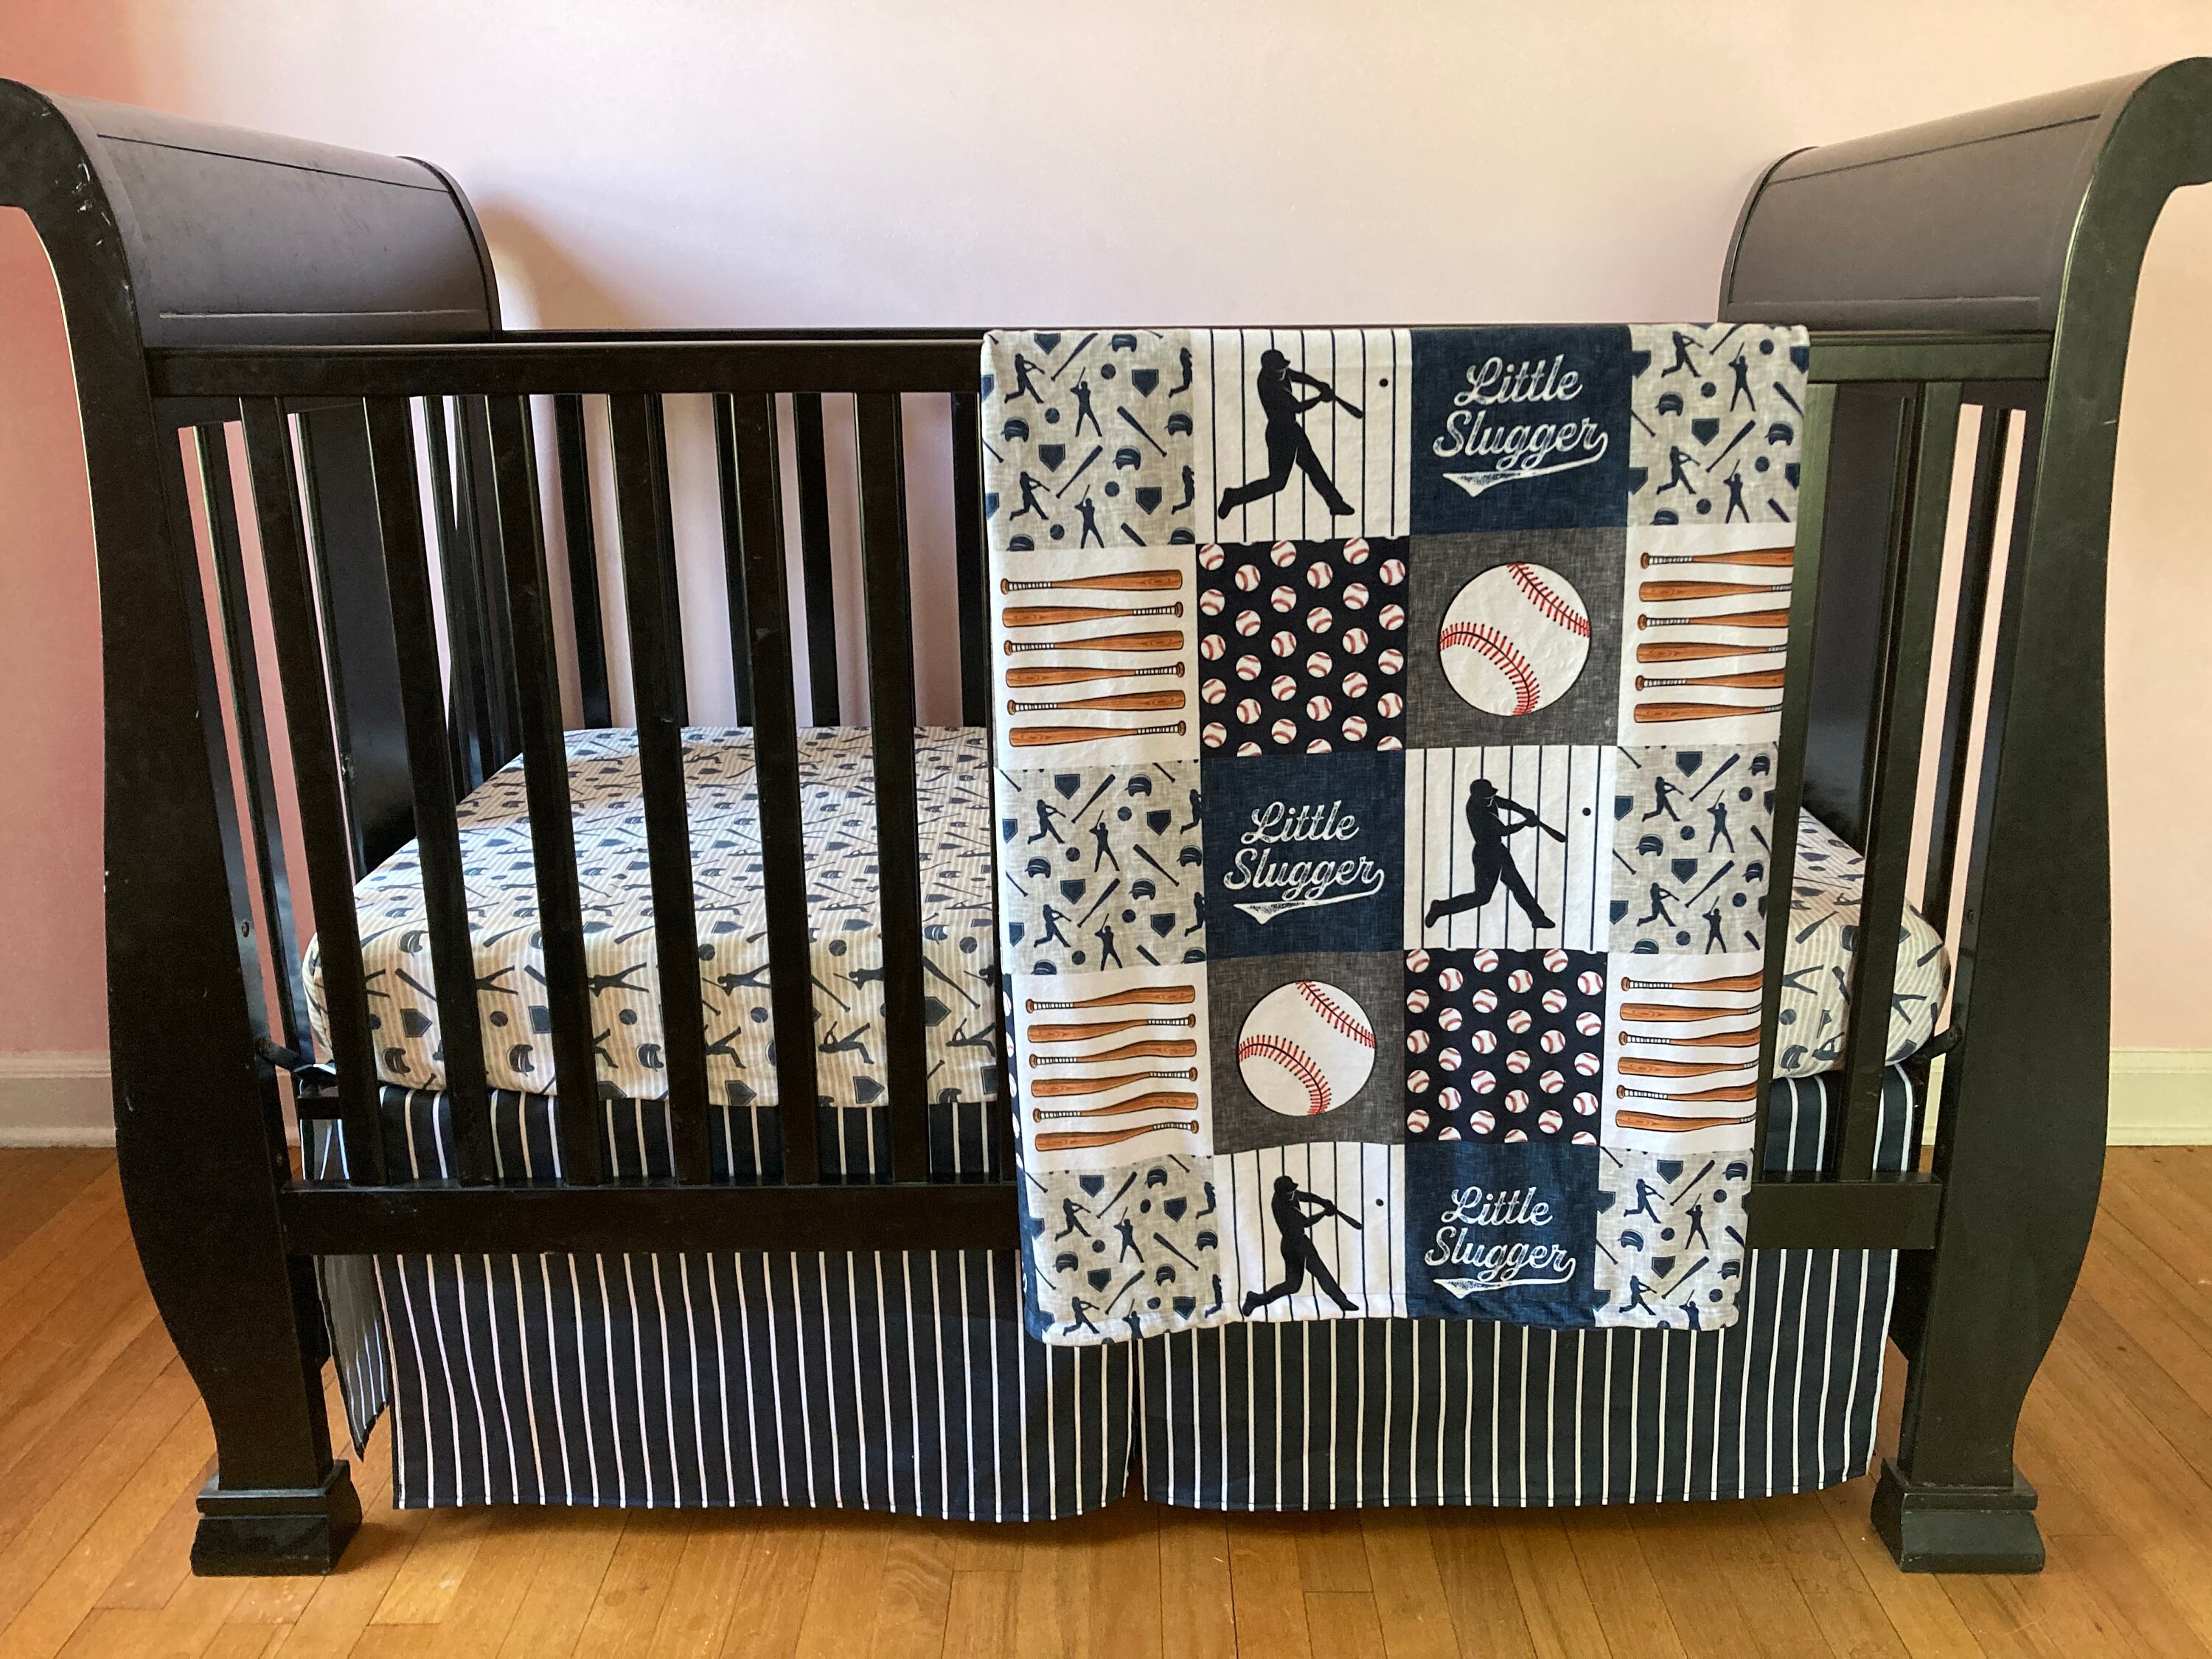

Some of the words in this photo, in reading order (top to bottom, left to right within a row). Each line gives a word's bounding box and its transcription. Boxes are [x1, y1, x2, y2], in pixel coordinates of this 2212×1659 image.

[1453, 353, 1583, 406] Little
[1433, 409, 1609, 472] Slugger
[1240, 800, 1360, 845] Little
[1223, 848, 1385, 902] Slugger
[1441, 1186, 1553, 1226] Little
[1425, 1225, 1576, 1282] Slugger
